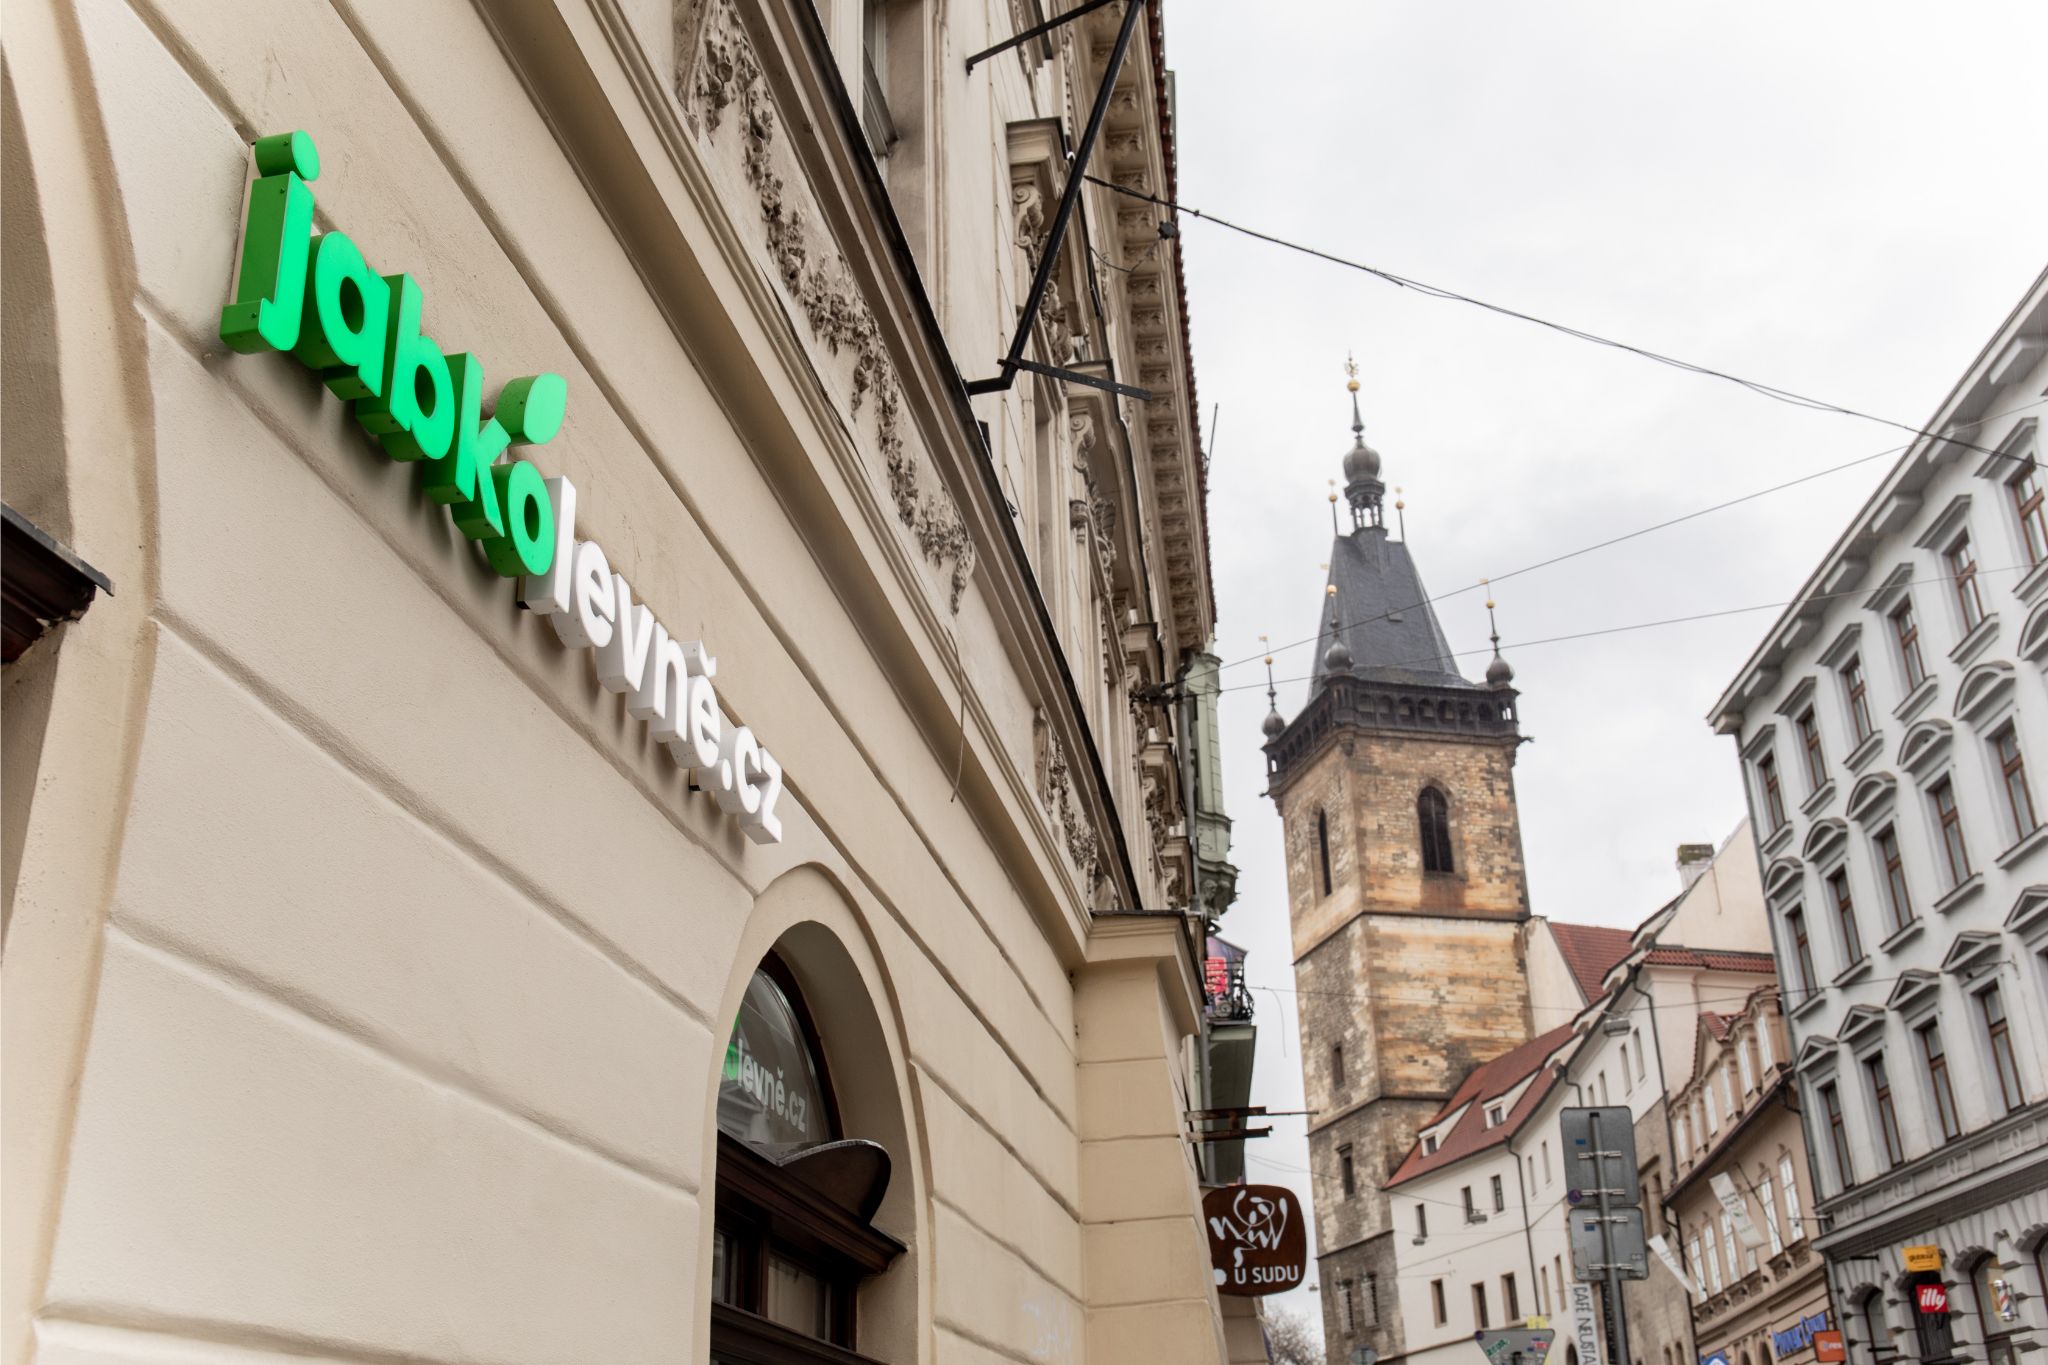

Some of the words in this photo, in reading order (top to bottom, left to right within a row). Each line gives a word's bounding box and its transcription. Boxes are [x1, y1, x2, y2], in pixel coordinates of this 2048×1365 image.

[722, 1038, 806, 1132] olevně.cz
[1234, 1267, 1247, 1285] U
[1252, 1264, 1299, 1284] SUDU
[1573, 1286, 1593, 1313] CAFÉ
[1920, 1288, 1946, 1311] illy
